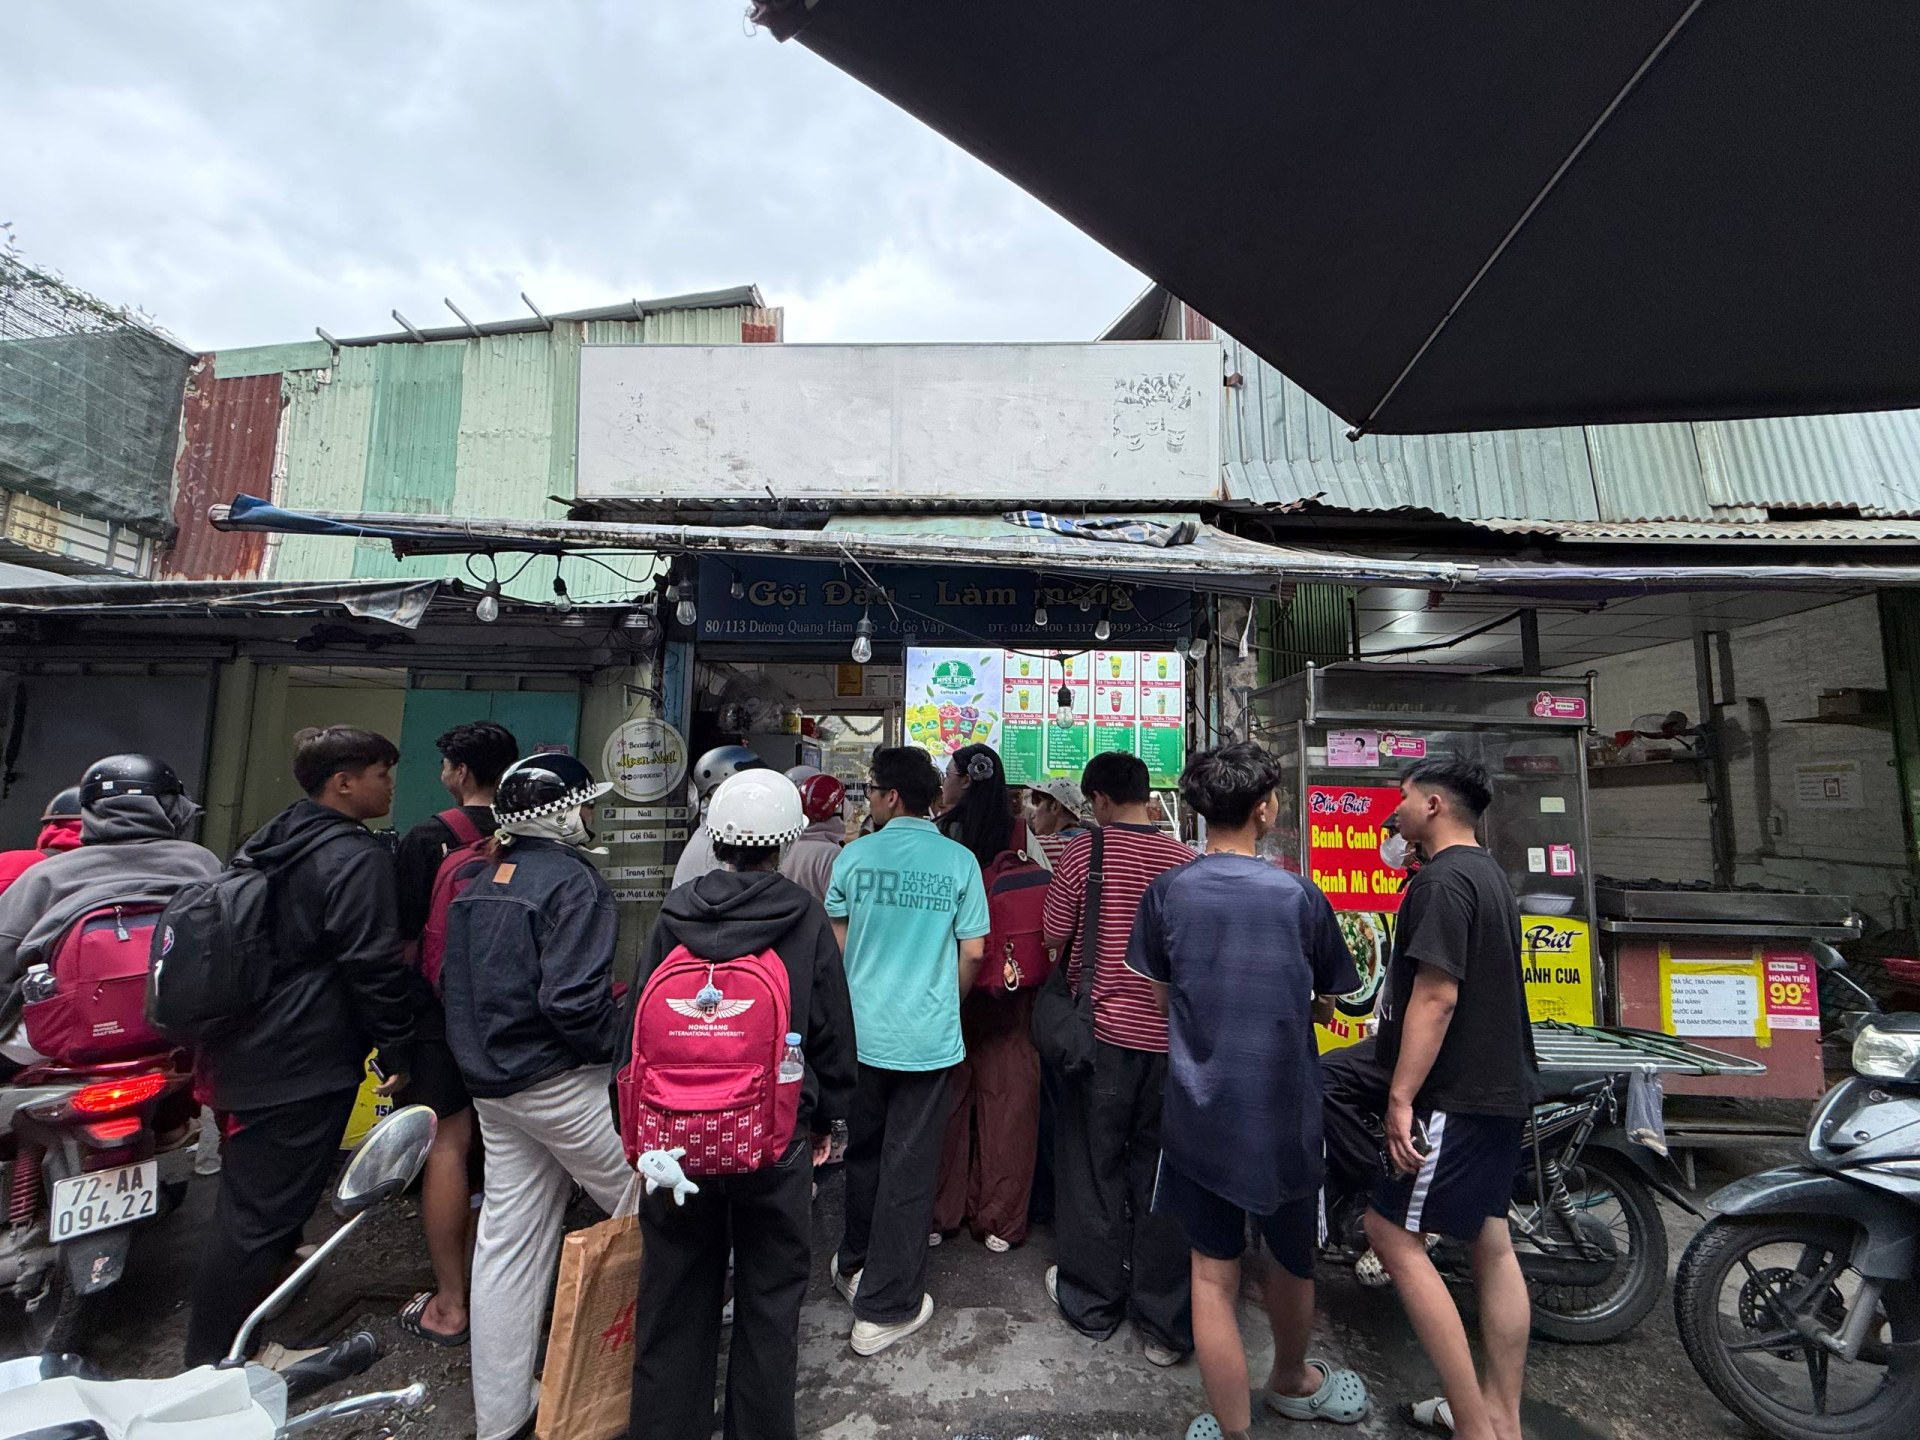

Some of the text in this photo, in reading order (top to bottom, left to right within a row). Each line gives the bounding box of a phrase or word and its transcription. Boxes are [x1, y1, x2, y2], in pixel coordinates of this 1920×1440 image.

[935, 580, 1018, 606] Làm
[705, 619, 746, 635] 80/113
[827, 619, 853, 633] Hàm
[1067, 623, 1094, 633] 1317
[1110, 622, 1131, 633] 939
[637, 806, 652, 817] Nail
[1311, 824, 1343, 849] Bánh
[1346, 825, 1377, 849] Canh
[902, 870, 953, 886] TALK MUCH
[1313, 868, 1347, 893] Bánh
[1351, 869, 1368, 893] Mì
[901, 880, 952, 898] DO MUCH
[899, 893, 952, 913] UNITED
[1525, 925, 1583, 953] Biệt
[1522, 968, 1581, 985] ANH CUA
[1768, 973, 1791, 982] HOÀN
[72, 1164, 144, 1206] 72-AA
[58, 1190, 153, 1236] 094.22
